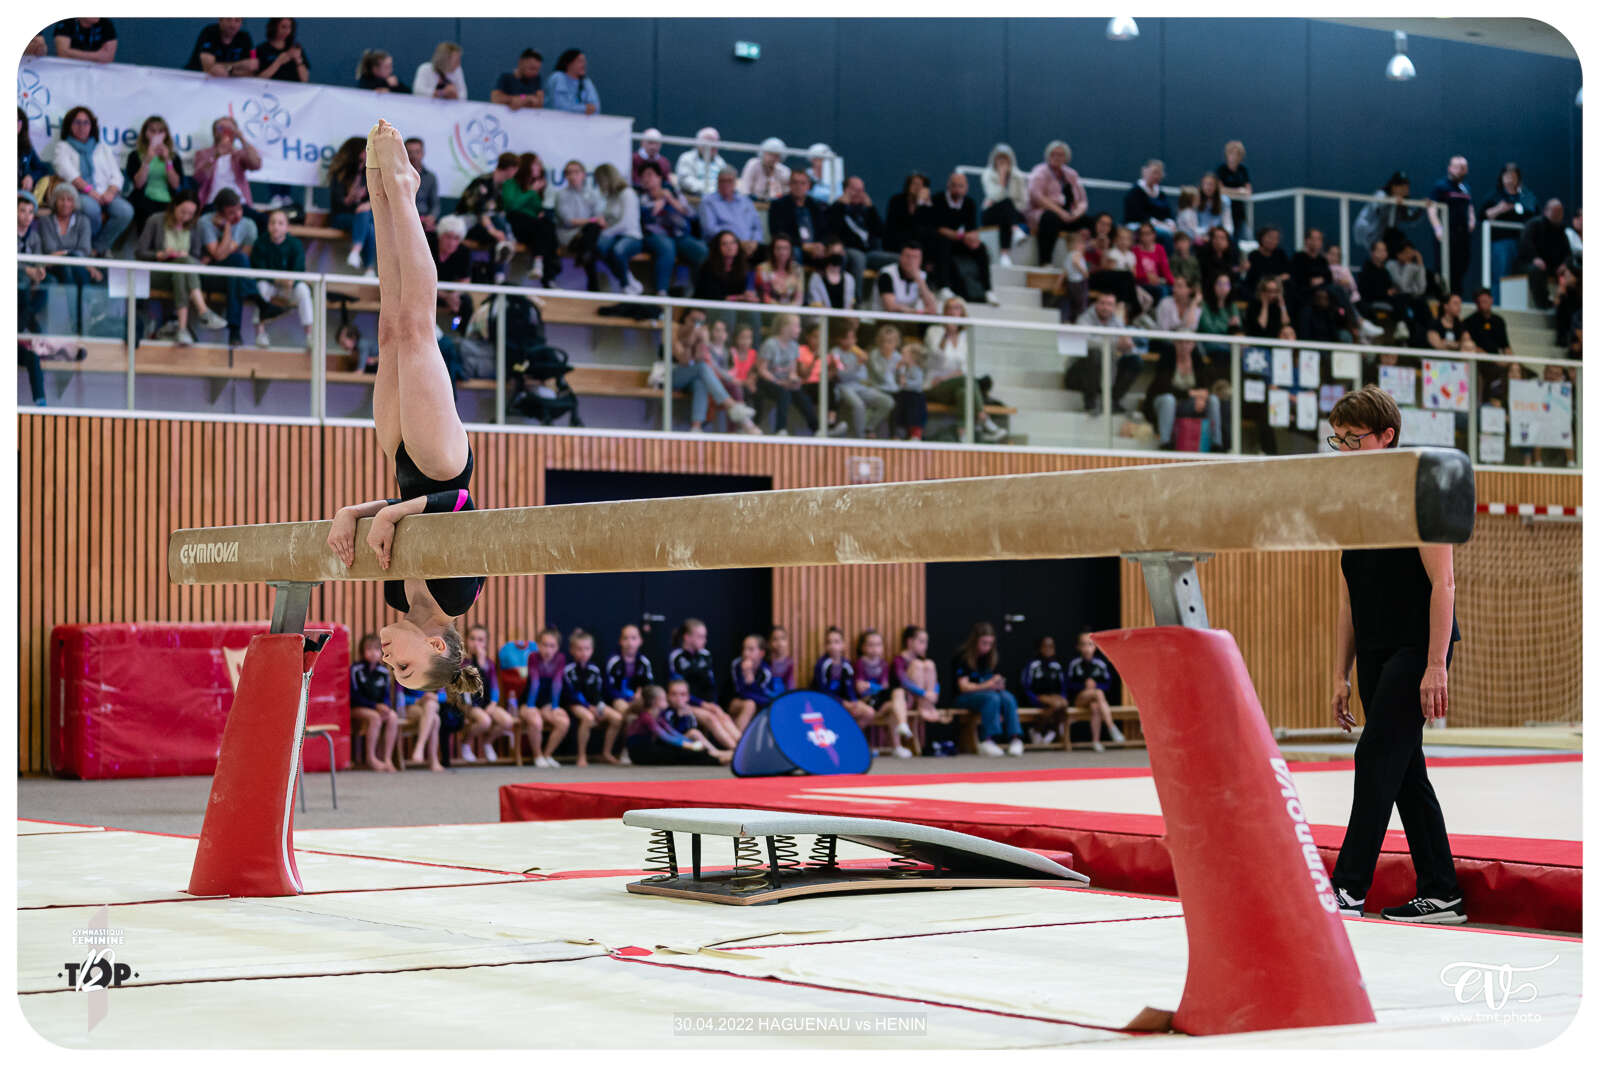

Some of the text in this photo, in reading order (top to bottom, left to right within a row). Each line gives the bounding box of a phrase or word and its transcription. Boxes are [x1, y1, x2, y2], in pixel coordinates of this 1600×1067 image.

[44, 115, 192, 152] Hueu
[180, 541, 239, 565] GYMNOVA
[1270, 758, 1337, 913] GYMNOVA
